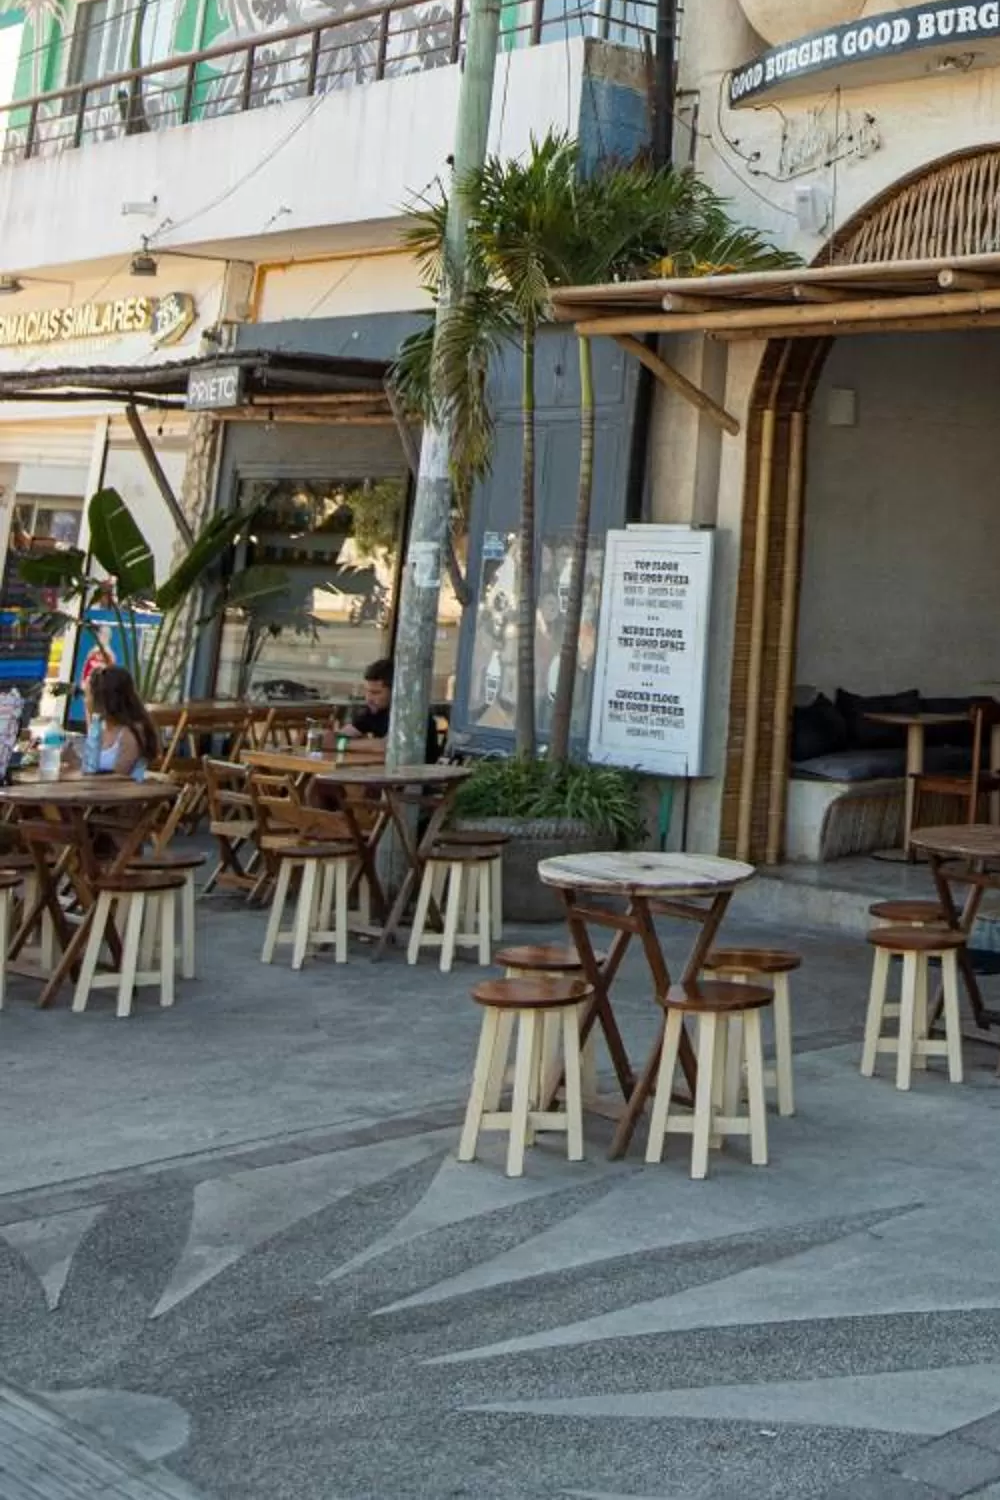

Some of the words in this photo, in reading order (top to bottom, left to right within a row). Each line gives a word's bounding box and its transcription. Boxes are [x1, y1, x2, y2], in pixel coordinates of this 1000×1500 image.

[731, 63, 762, 99] GOOD
[765, 34, 838, 88] BURGER
[841, 18, 911, 56] GOOD
